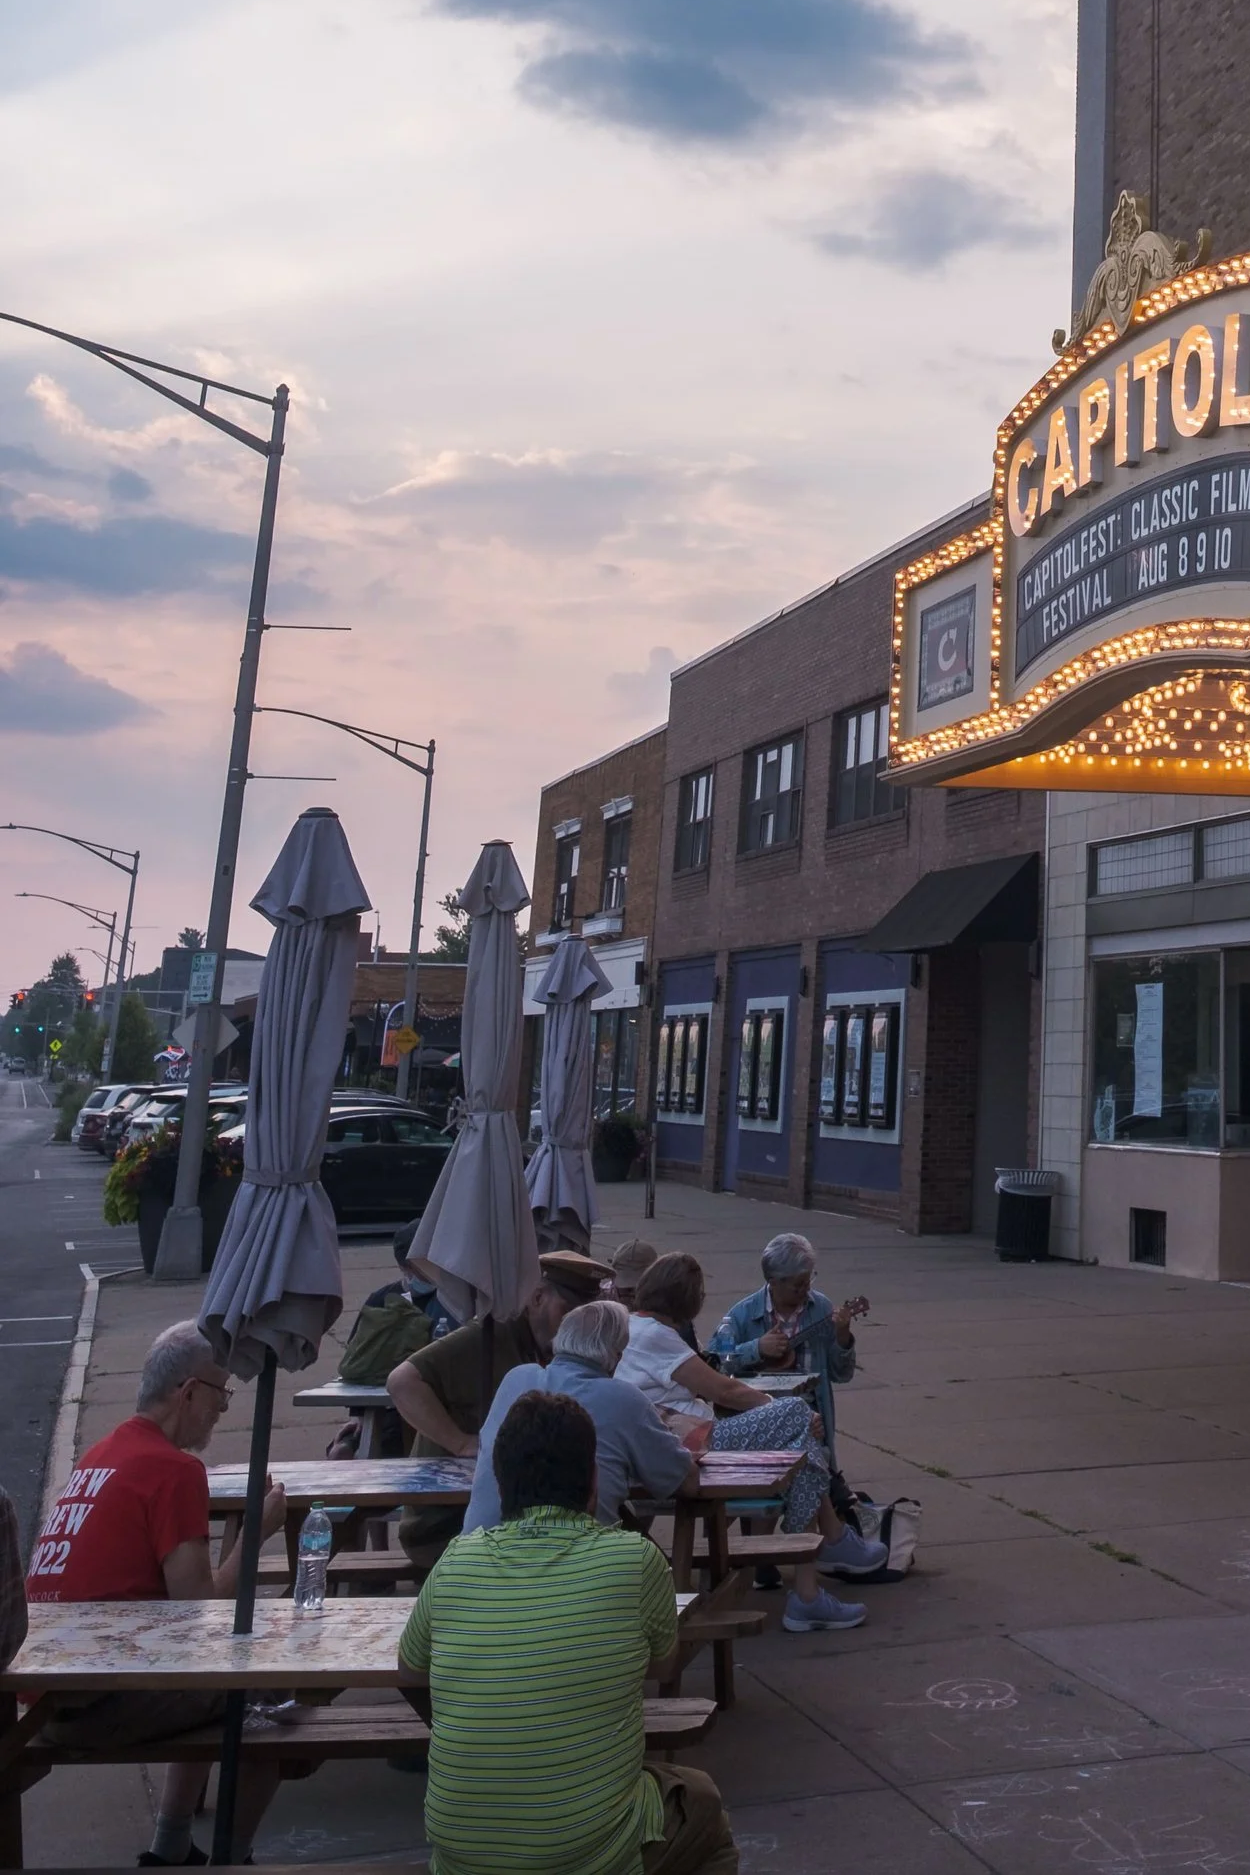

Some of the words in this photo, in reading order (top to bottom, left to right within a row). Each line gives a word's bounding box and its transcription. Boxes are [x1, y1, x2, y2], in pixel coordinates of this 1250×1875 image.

[1024, 514, 1121, 611] CAPITOLFEST:
[1131, 479, 1199, 541] CLASSIC
[1042, 568, 1112, 643] FESTIVAL
[1138, 542, 1168, 590] AUG
[1178, 536, 1188, 577] 8
[1196, 532, 1207, 573] 9
[1214, 527, 1232, 570] 10
